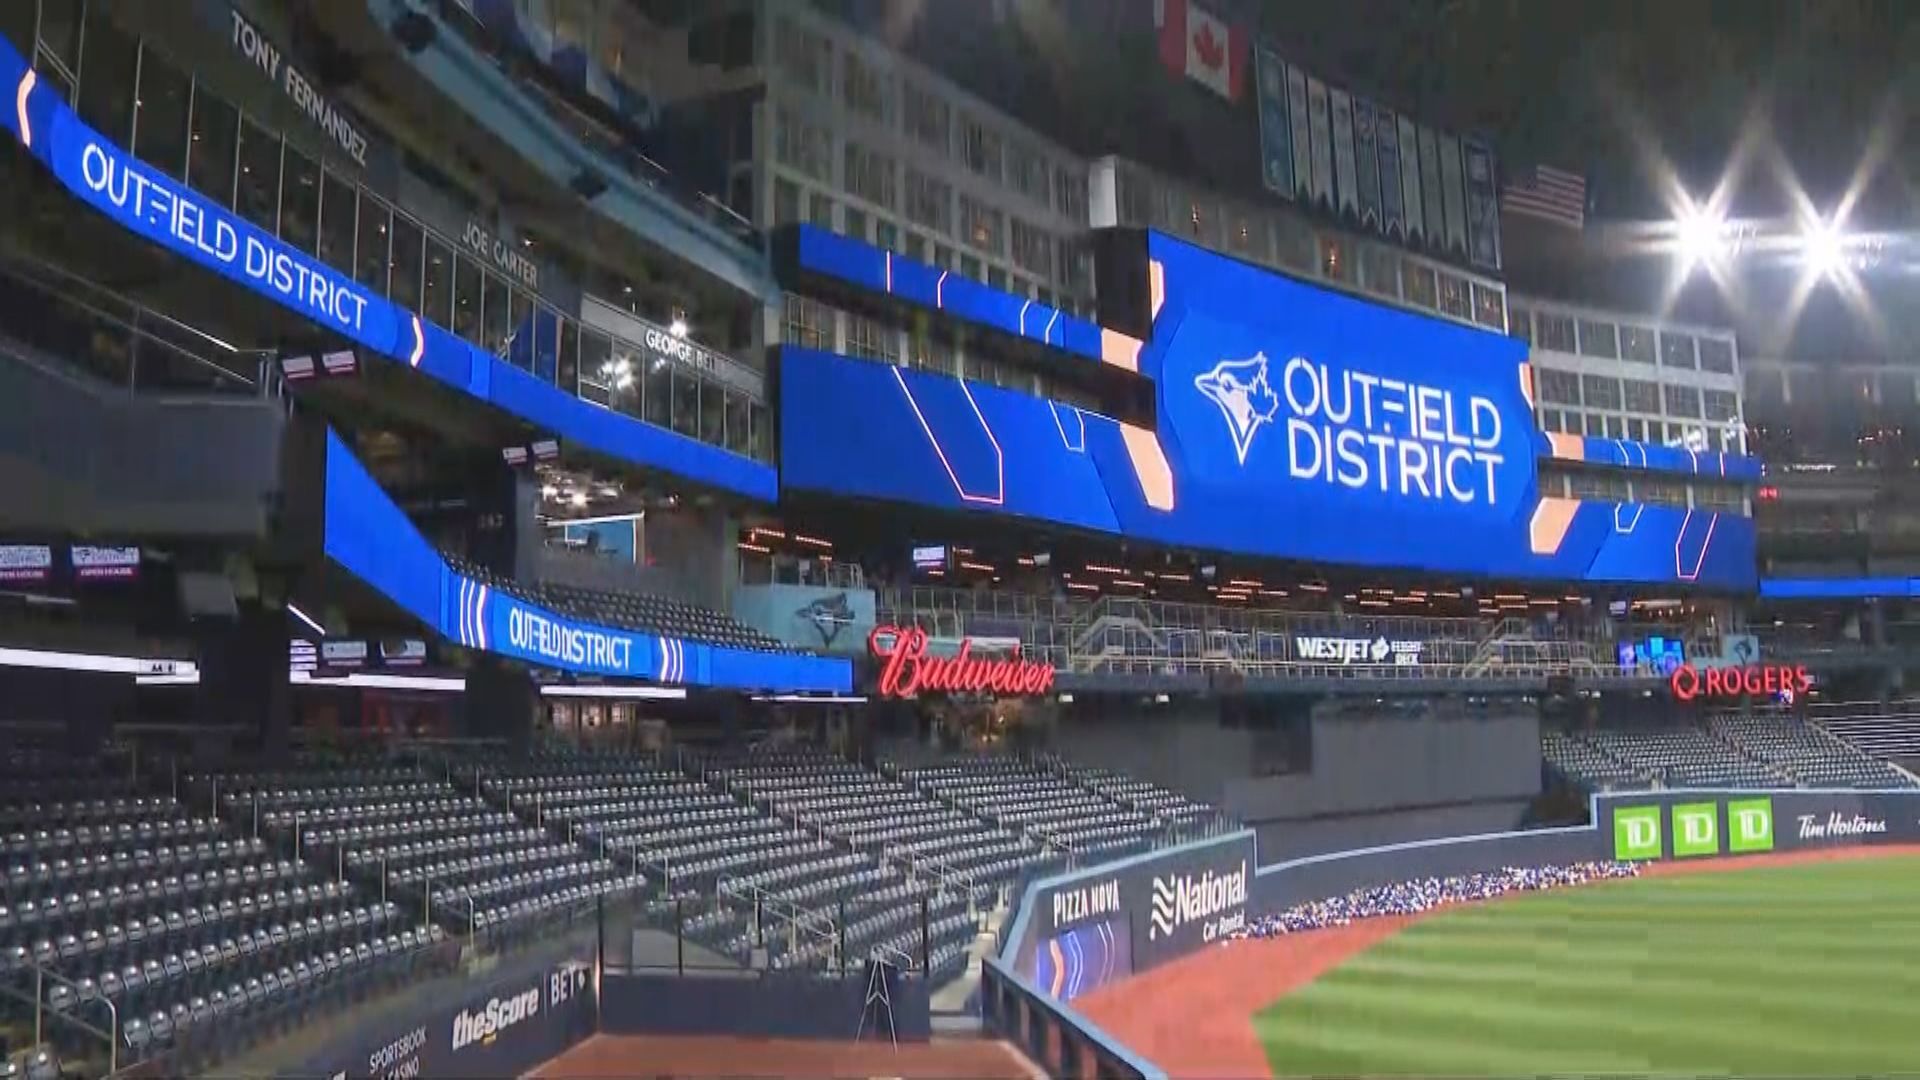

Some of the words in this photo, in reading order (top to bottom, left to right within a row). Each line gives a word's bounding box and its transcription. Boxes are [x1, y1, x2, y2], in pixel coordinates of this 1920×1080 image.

[232, 10, 280, 80] TONY
[286, 65, 367, 168] FERNANDEZ
[82, 143, 237, 263] OUTFIELD
[246, 235, 368, 331] DISTRICT
[462, 221, 488, 256] JOE
[493, 240, 537, 289] CARTER
[646, 328, 693, 364] GEORGE
[1284, 357, 1502, 449] OUTFIELD
[1287, 418, 1504, 504] DISTRICT
[561, 627, 632, 670] DISTRICT
[868, 624, 1056, 697] Budweiser
[1297, 636, 1371, 666] WESTJET
[1706, 665, 1809, 697] ROGERS
[1619, 816, 1657, 849] TD
[1674, 812, 1714, 845] TD
[1736, 808, 1769, 840] TD
[1797, 813, 1825, 839] Tim
[1827, 810, 1886, 837] Hortons
[1053, 888, 1089, 929] PIZZA
[1091, 878, 1120, 917] NOVA
[1175, 858, 1248, 926] National
[452, 987, 540, 1050] theScore
[551, 964, 577, 1007] BET
[369, 1025, 426, 1075] SPORTSBOOK
